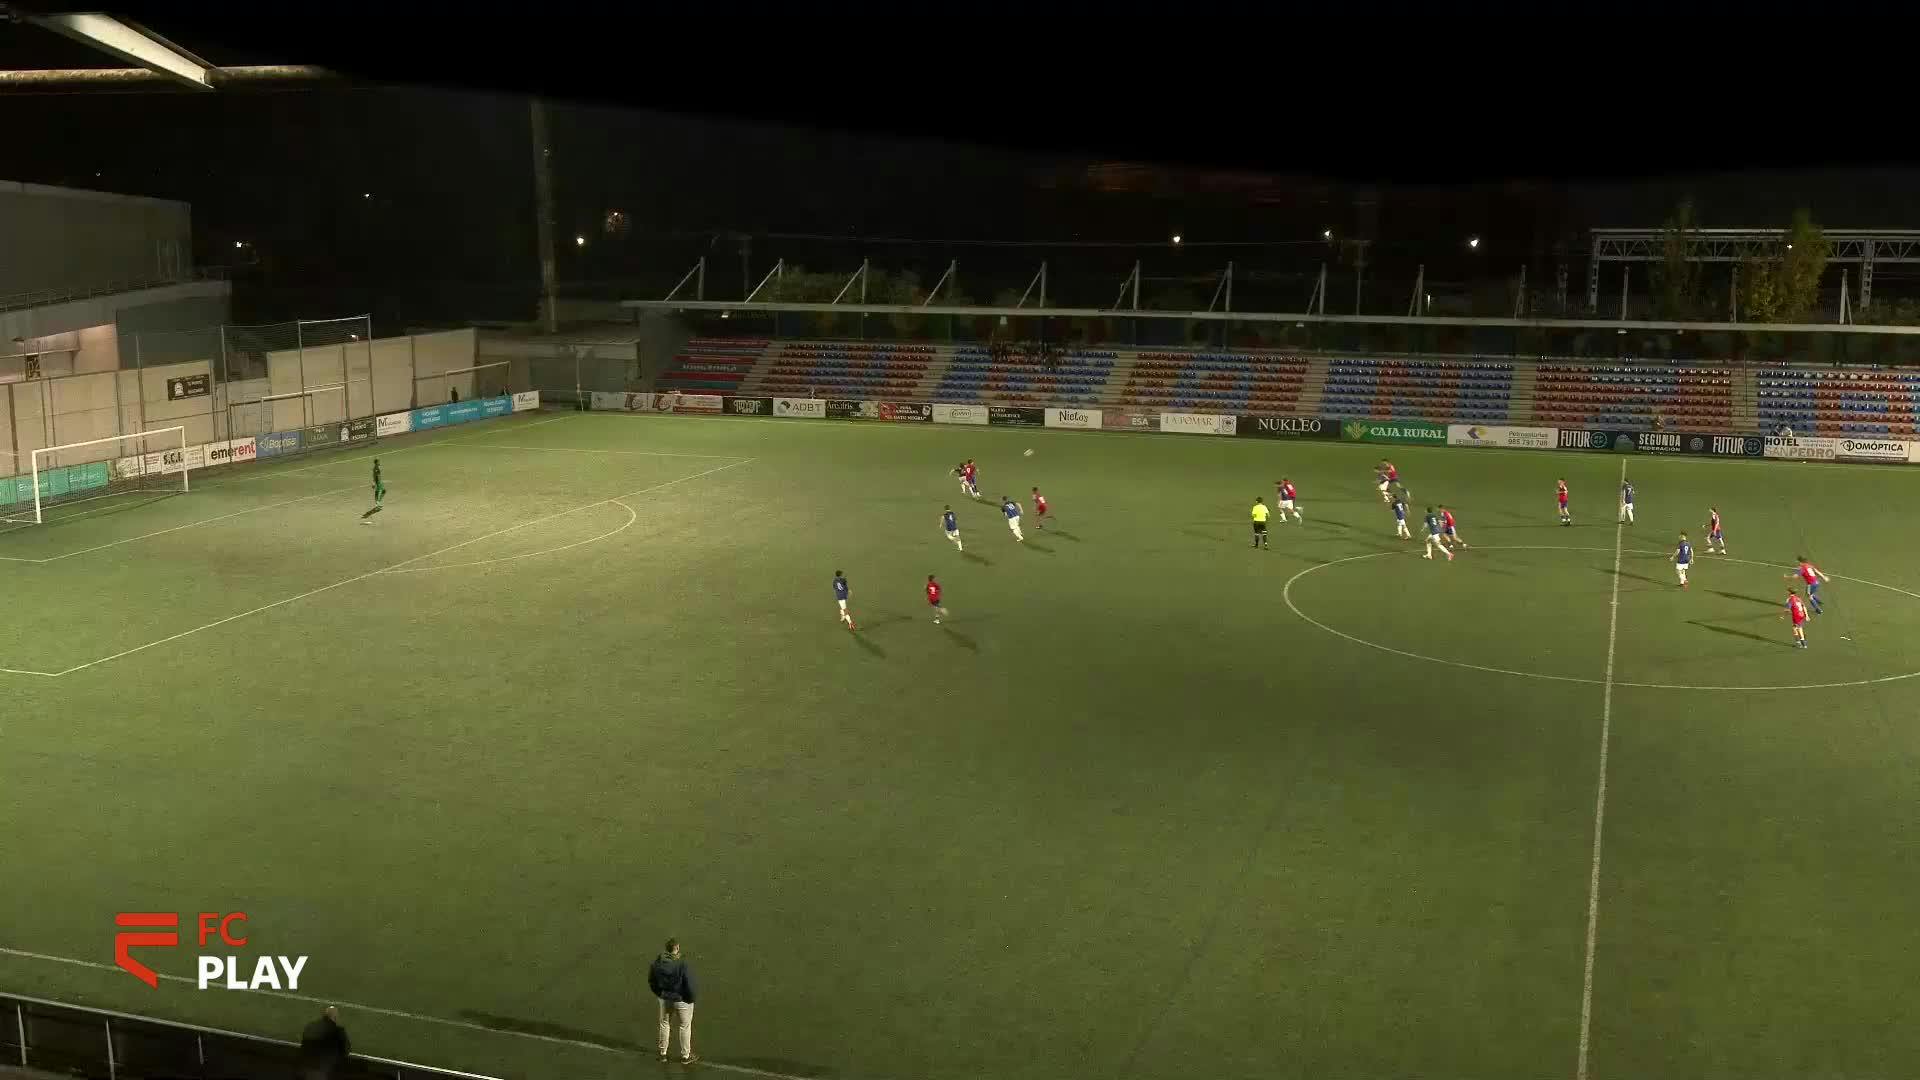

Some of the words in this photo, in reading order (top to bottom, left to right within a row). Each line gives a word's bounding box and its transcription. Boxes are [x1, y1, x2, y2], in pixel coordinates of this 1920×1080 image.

[1058, 410, 1089, 423] Nietos
[1257, 418, 1322, 432] NUKLEO
[1370, 427, 1401, 437] CAJA
[1403, 428, 1446, 439] RURAL
[1639, 433, 1682, 447] SEGUNDA
[1765, 437, 1799, 446] HOTEL
[211, 441, 256, 460] emerent
